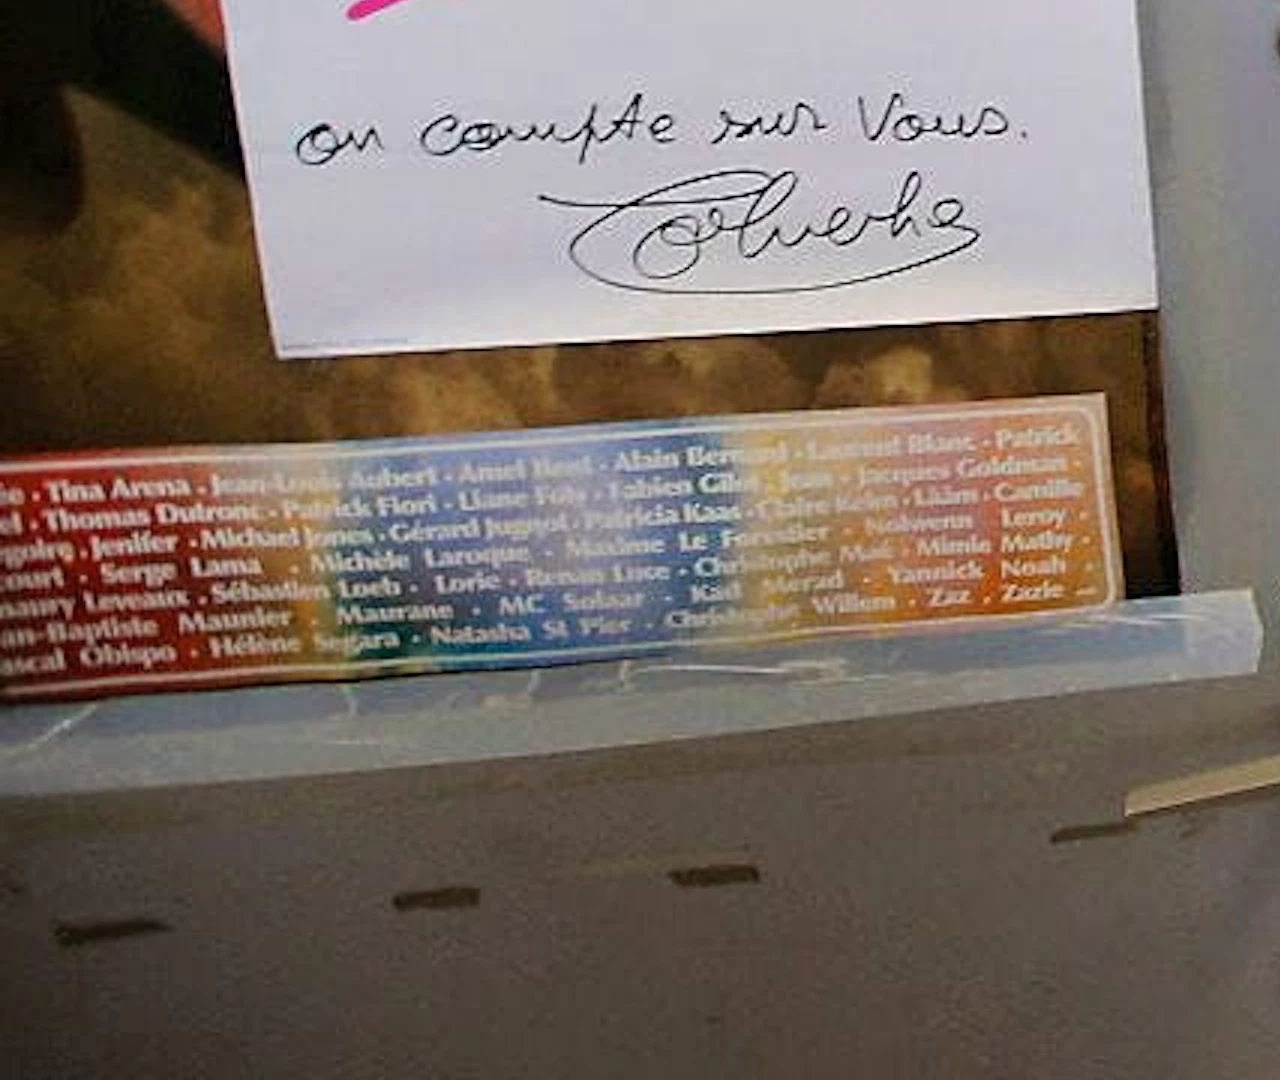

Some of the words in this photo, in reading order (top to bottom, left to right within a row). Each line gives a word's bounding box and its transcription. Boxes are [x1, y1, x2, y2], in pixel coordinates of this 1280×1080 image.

[295, 121, 383, 167] on
[420, 92, 676, 166] compte
[710, 99, 825, 143] sur
[41, 507, 151, 533] Thomas
[155, 502, 260, 526] Dutronc
[376, 494, 437, 517] Fiori
[958, 454, 1068, 481] Goldman
[44, 478, 106, 503] Tina
[110, 477, 192, 500] Arena
[617, 448, 680, 471] Alain
[908, 433, 977, 455] Blanc
[995, 422, 1081, 449] Patrick
[82, 587, 192, 613] Leveaux
[336, 577, 402, 600] Loeb
[433, 570, 501, 596] Lorie
[1001, 528, 1074, 555] Mathy
[90, 529, 179, 562] Jenifer
[303, 523, 374, 551] Jones
[388, 517, 480, 542] Gérard
[682, 500, 742, 524] Kaas
[100, 560, 178, 589] Serge
[190, 555, 264, 579] Lama
[424, 545, 530, 572] Laroque
[677, 530, 709, 553] Le
[1001, 508, 1070, 531] Leroy
[78, 640, 177, 670] Obispo
[429, 622, 532, 646] Natasha
[928, 588, 972, 608] Zaz
[1001, 582, 1066, 606] Zazie
[178, 606, 293, 635] Maunier
[335, 601, 455, 627] Maurane
[499, 593, 545, 616] MC
[1000, 555, 1067, 580] Noah
